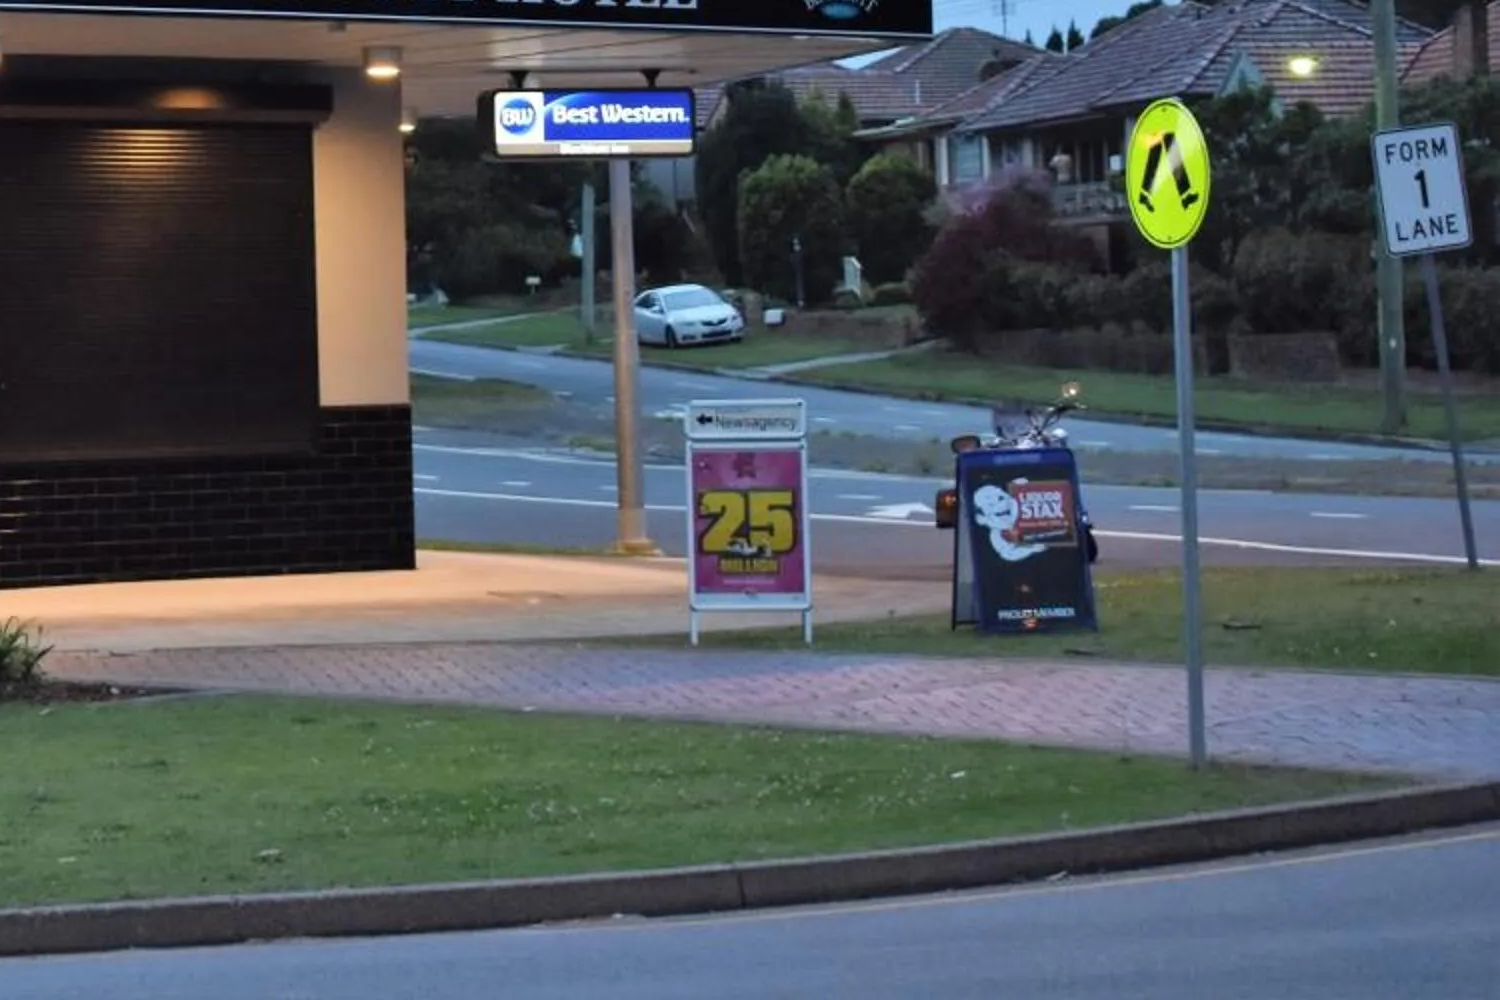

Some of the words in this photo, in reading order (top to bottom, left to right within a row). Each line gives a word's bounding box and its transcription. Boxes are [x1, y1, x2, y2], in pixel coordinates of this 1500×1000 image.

[553, 104, 600, 124] Best
[1385, 137, 1447, 165] FORM
[1413, 169, 1430, 209] 1
[1395, 213, 1459, 242] LANE
[715, 414, 797, 432] Newsagency
[700, 490, 797, 555] 25
